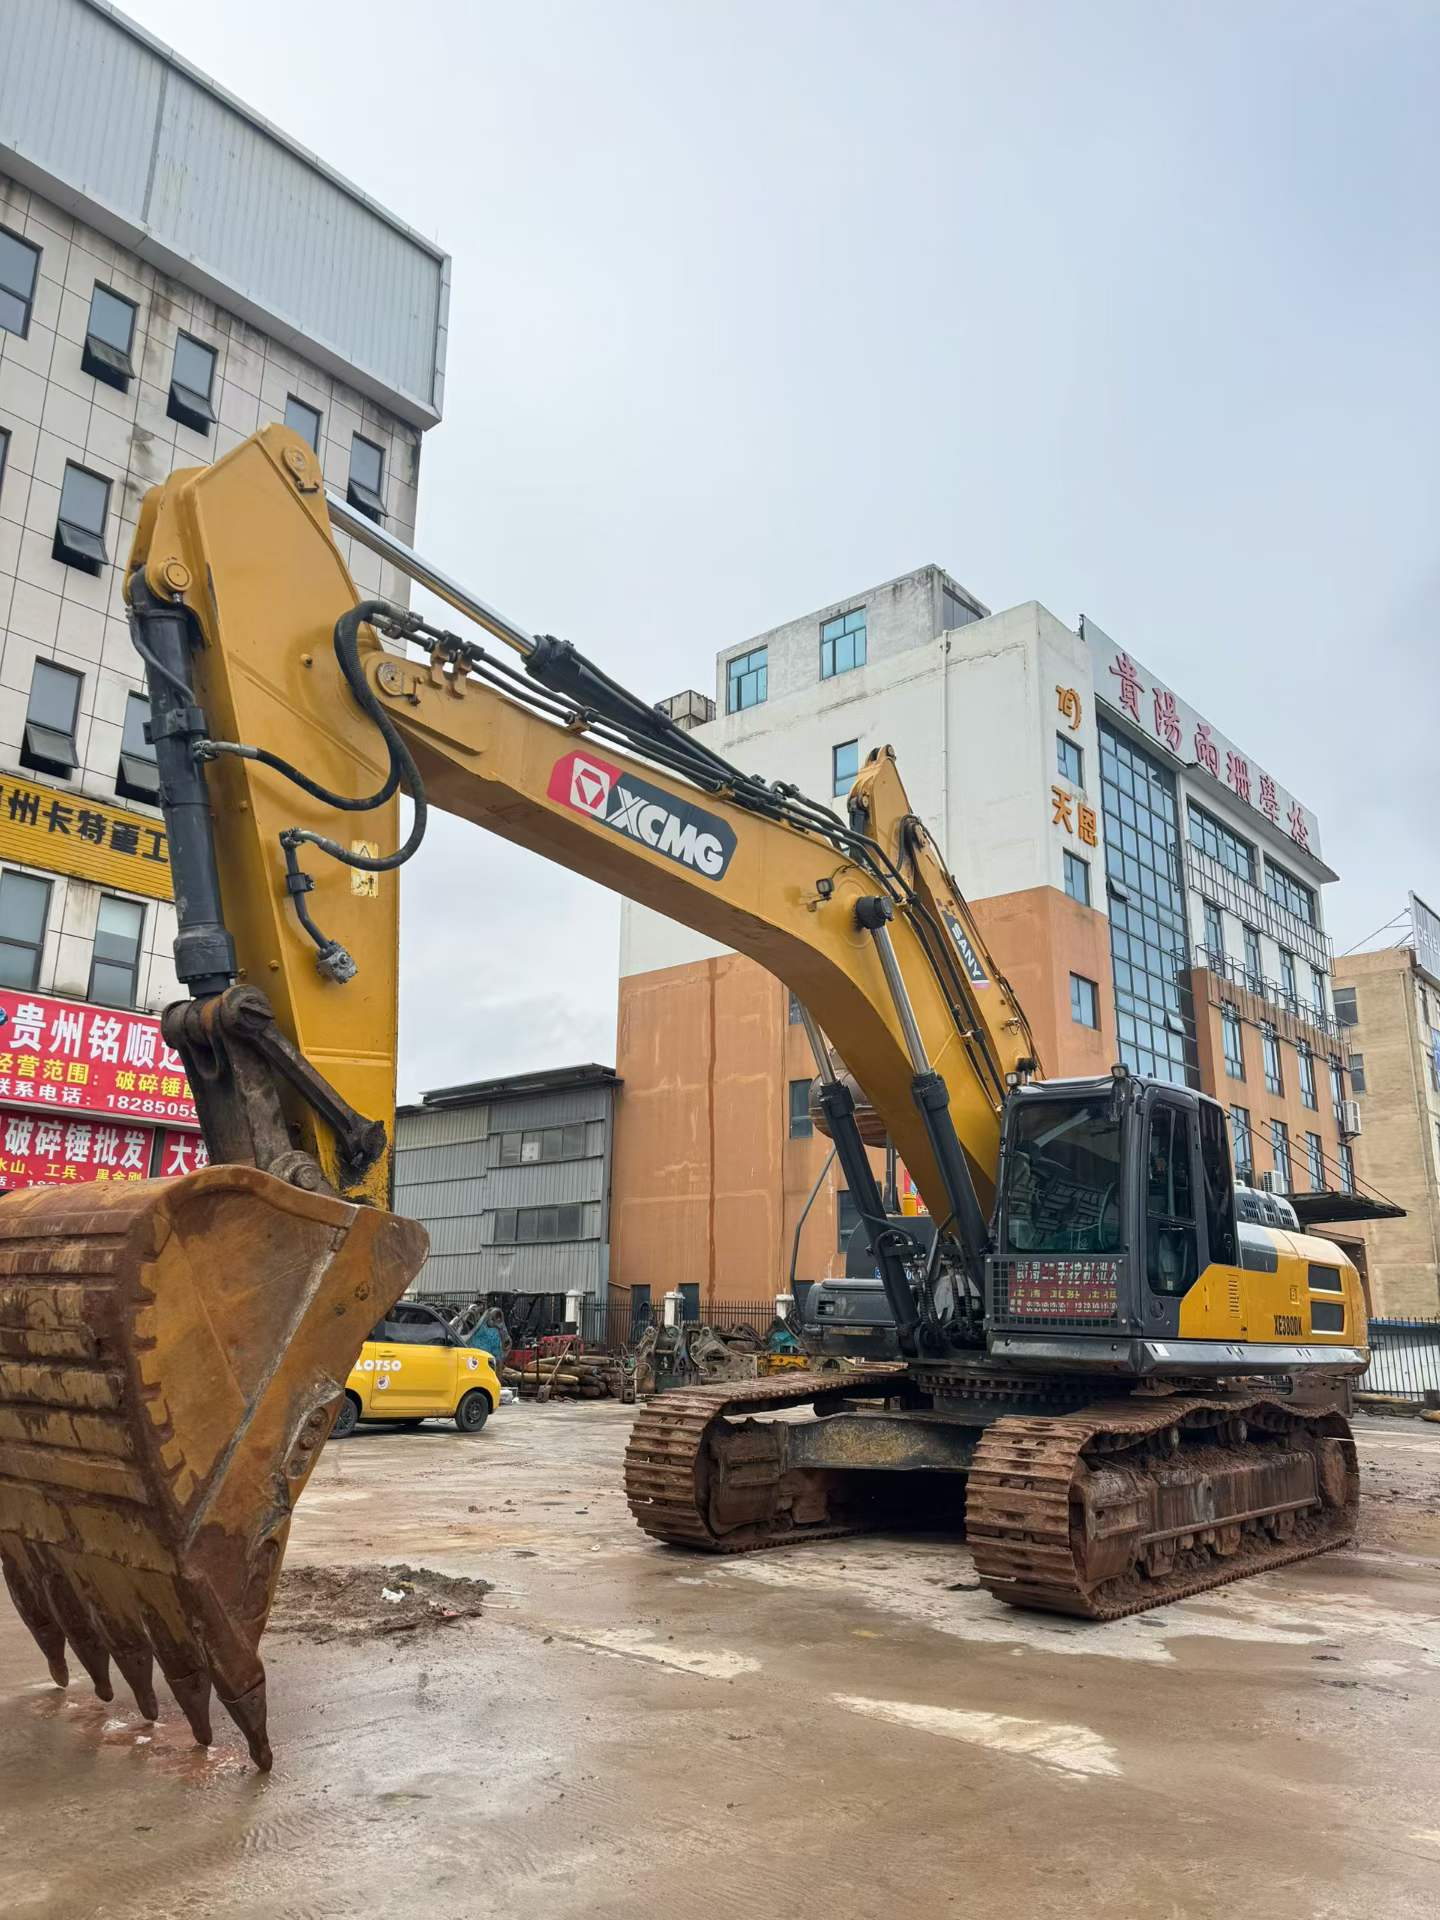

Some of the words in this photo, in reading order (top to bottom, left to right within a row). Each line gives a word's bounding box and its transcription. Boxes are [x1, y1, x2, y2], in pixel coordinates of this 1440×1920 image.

[0, 785, 169, 863] 州卡特重工
[606, 785, 724, 875] XCMG
[1051, 785, 1098, 848] 天恩
[951, 922, 982, 978] SANY
[5, 1116, 146, 1169] 破碎锤批发
[355, 1360, 402, 1372] LOTSO
